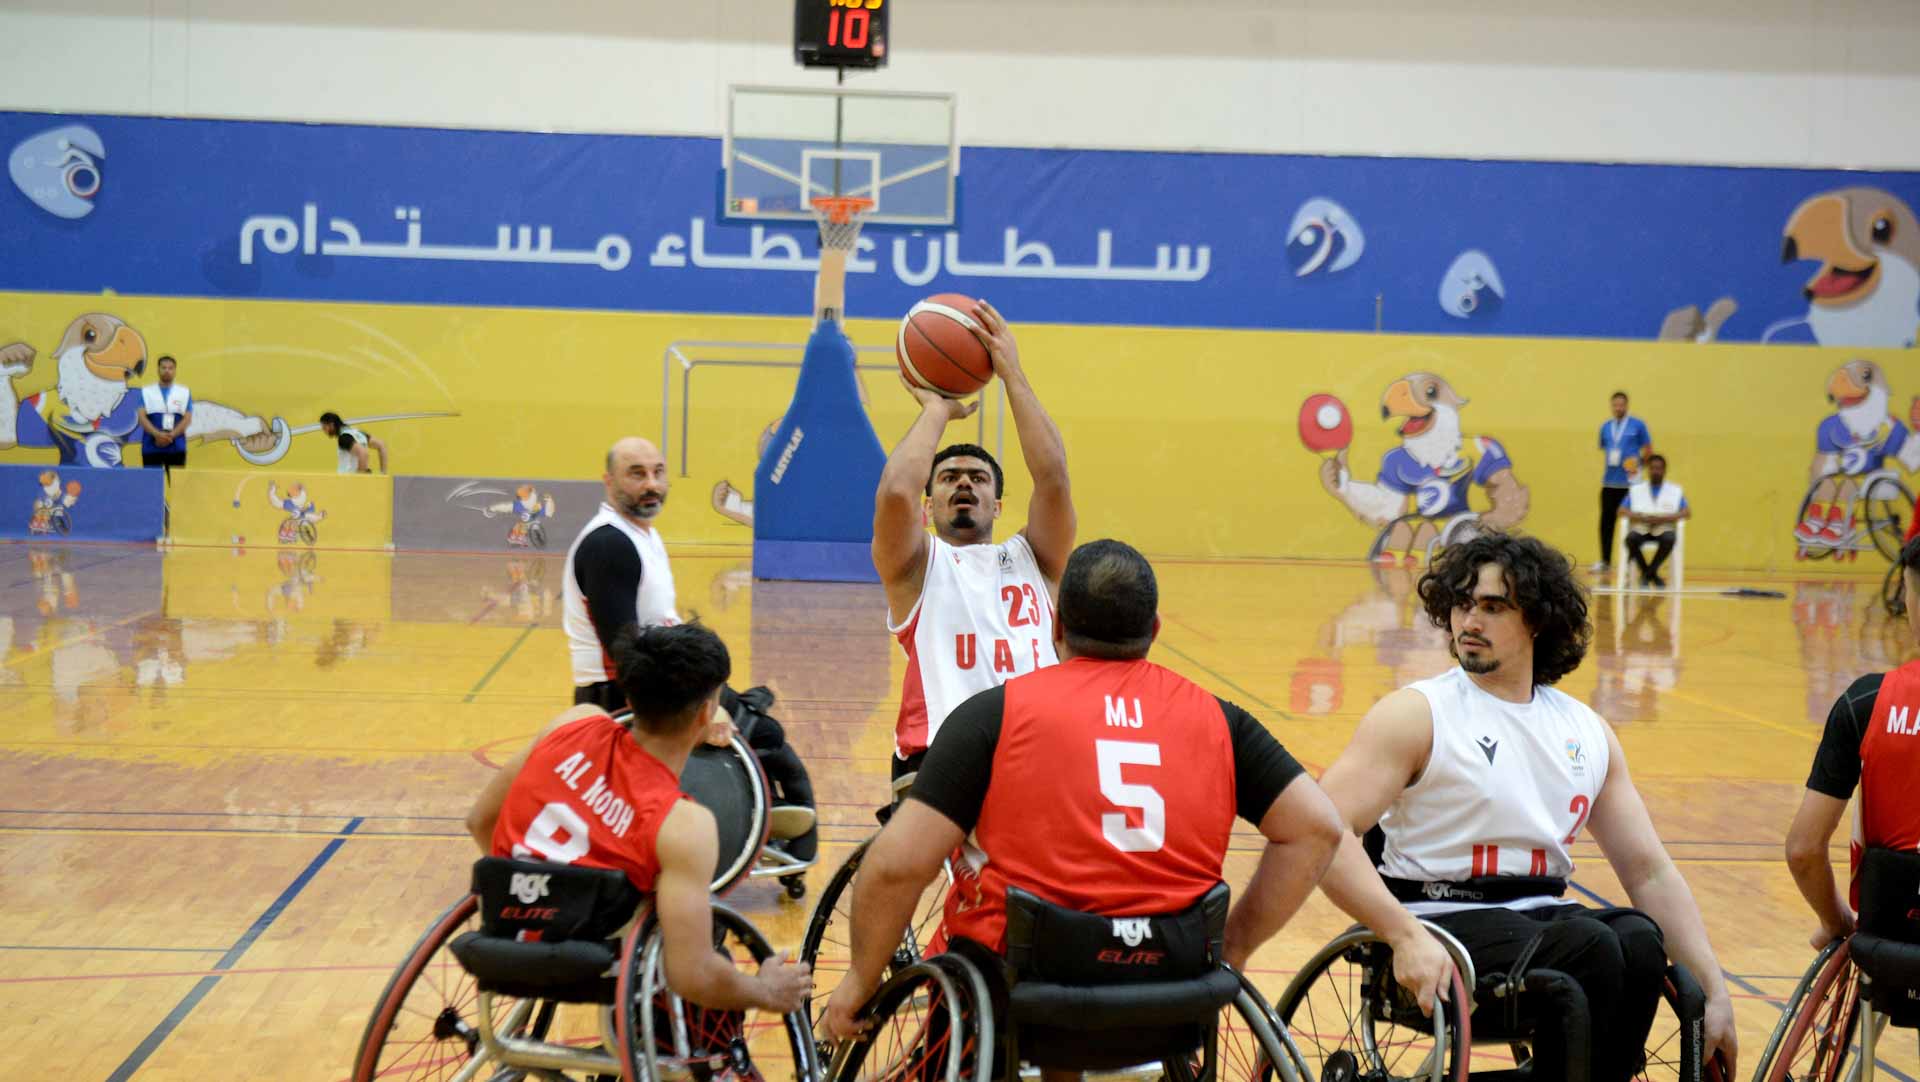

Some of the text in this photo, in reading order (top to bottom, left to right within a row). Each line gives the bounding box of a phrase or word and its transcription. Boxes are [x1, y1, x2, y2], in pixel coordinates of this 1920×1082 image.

[827, 9, 870, 49] 10
[240, 202, 632, 272] مستدام
[892, 227, 1211, 287] سلطان
[1001, 583, 1041, 628] 23
[1104, 694, 1144, 729] MJ
[553, 751, 593, 791] AL
[1095, 738, 1166, 853] 5
[1562, 794, 1591, 846] 2
[500, 907, 560, 921] ELITE
[1097, 950, 1166, 965] ELITE
